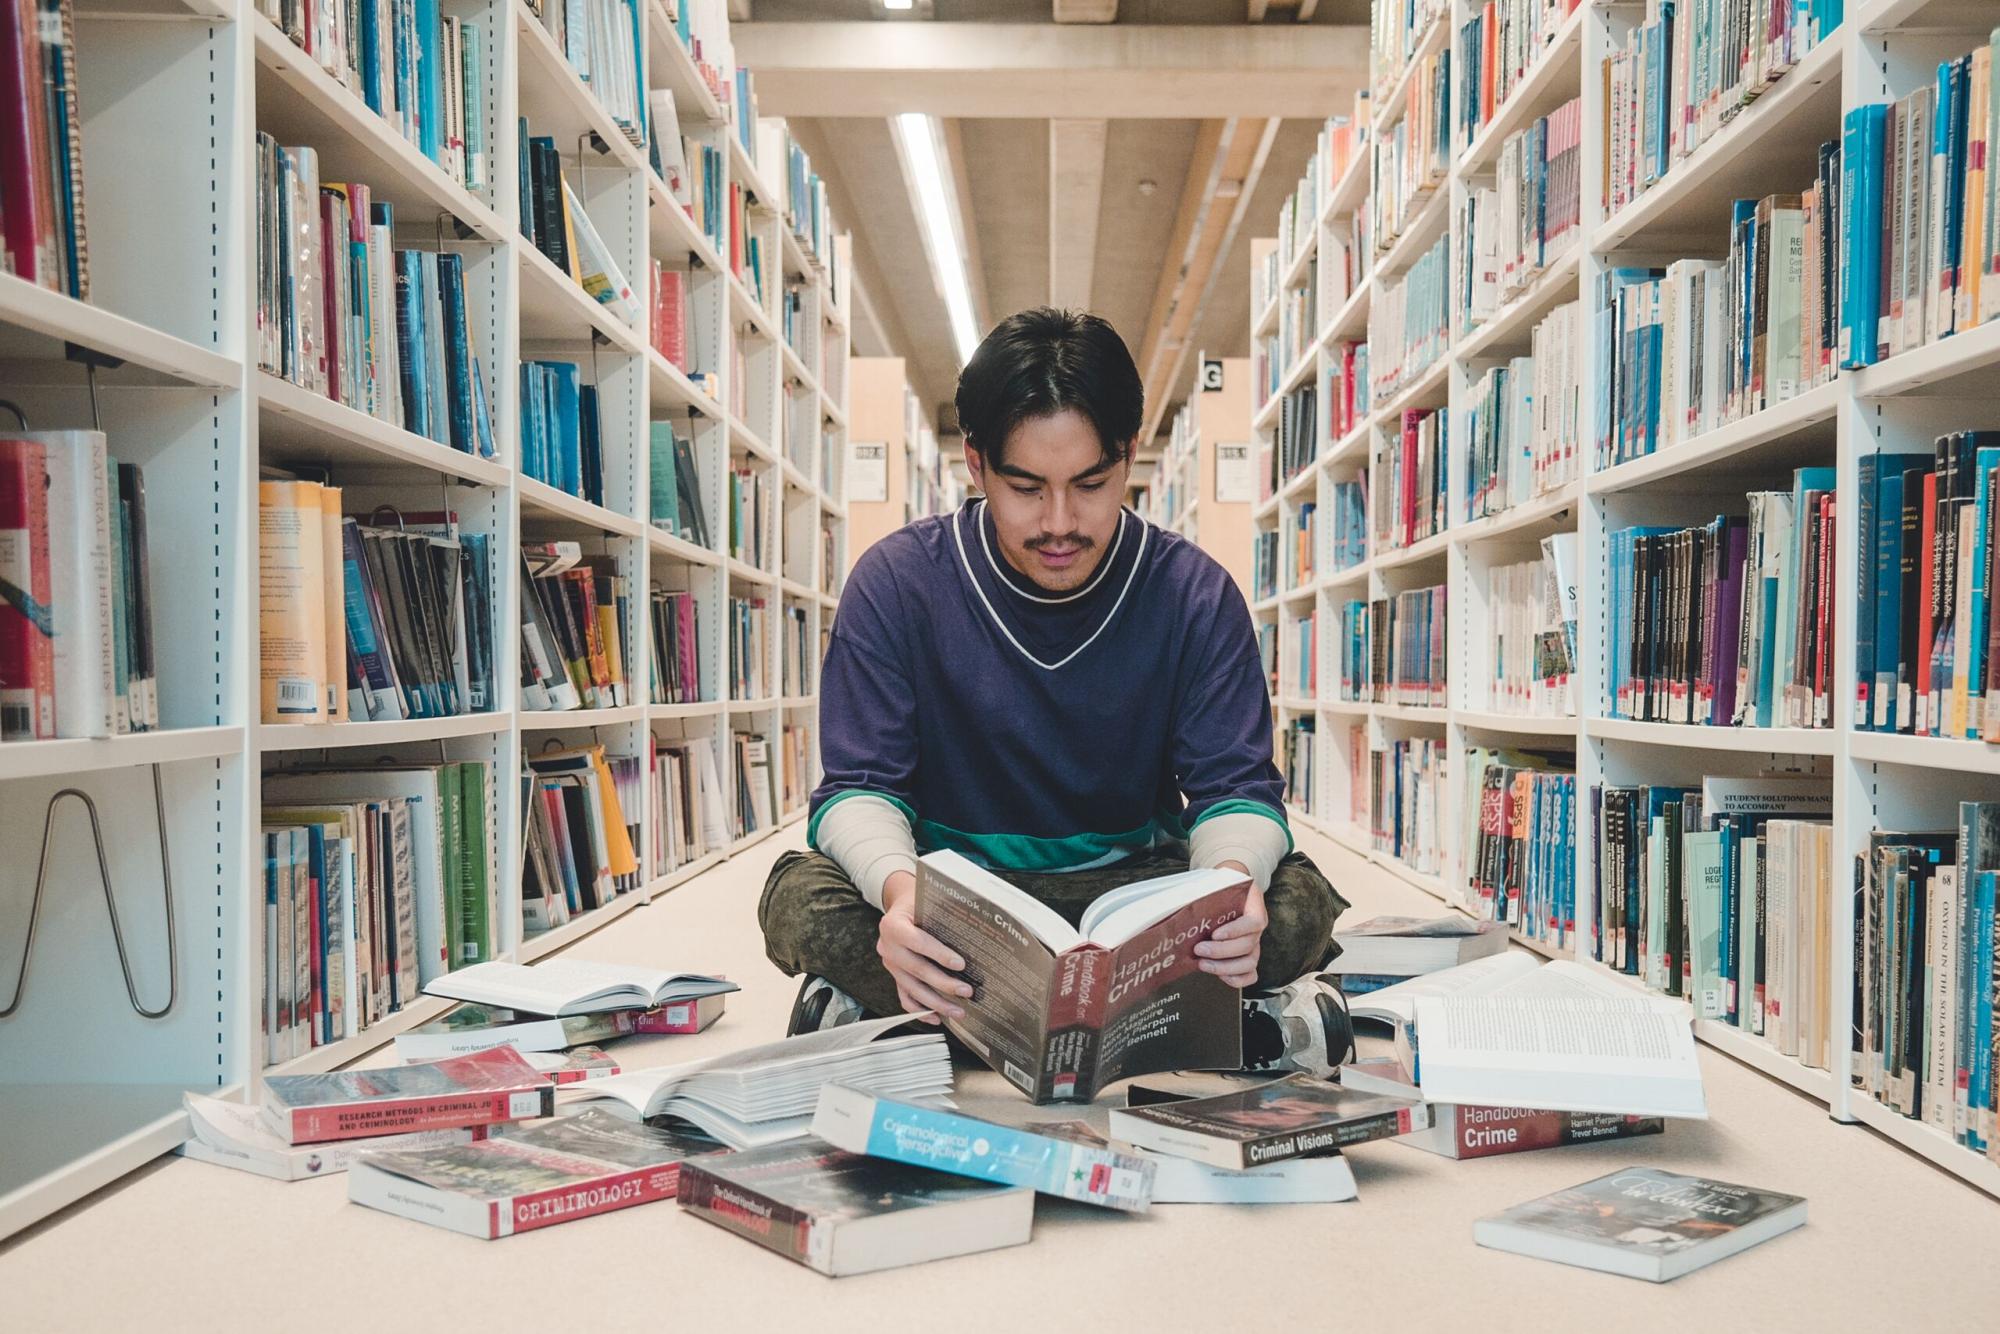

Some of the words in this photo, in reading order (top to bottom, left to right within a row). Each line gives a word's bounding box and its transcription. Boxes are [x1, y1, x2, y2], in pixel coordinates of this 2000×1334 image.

[1897, 117, 1905, 154] LINEAR
[1895, 158, 1903, 245] PROGRAMMING
[1204, 364, 1222, 388] G
[92, 446, 104, 534] NATURAL
[1986, 480, 1995, 544] Mathematical
[1858, 494, 1873, 601] Astronomy
[1983, 546, 1992, 599] Astronomy
[100, 587, 112, 691] HISTORIES
[1742, 615, 1750, 655] ANALYSIS
[452, 795, 460, 856] Maths
[1487, 793, 1501, 831] SPSS
[1513, 796, 1523, 827] SPSS
[1960, 824, 1969, 862] British
[1729, 846, 1737, 895] Smoothing
[1943, 874, 1952, 886] 68
[1959, 864, 1968, 895] Town
[925, 871, 980, 912] Handbook
[994, 914, 1029, 947] Crime
[1942, 901, 1950, 952] OXYGEN
[1957, 896, 1967, 927] Maps
[1111, 918, 1212, 984] Handbook
[1217, 910, 1237, 924] on
[1971, 908, 1981, 952] Principles
[1986, 924, 1994, 946] New
[1060, 954, 1080, 996] Crime
[1078, 950, 1099, 1005] Handbook
[1941, 954, 1949, 967] IN
[1973, 954, 1980, 963] of
[1983, 948, 1993, 1004] Cosmology
[1108, 954, 1176, 1003] Crime
[1940, 974, 1948, 996] THE
[1970, 964, 1978, 1008] cosmology
[1124, 1008, 1163, 1034] Maguire
[1129, 992, 1180, 1022] Brookman
[1133, 1011, 1180, 1036] Pierpoint
[1939, 1000, 1947, 1038] SOLAR
[1127, 1026, 1168, 1047] Bennett
[1969, 1028, 1977, 1075] gravitation
[1937, 1041, 1946, 1087] SYSTEM
[338, 1110, 383, 1121] RESEARCH
[386, 1107, 424, 1118] METHODS
[438, 1103, 477, 1112] CRIMINAL
[339, 1122, 356, 1131] AND
[360, 1118, 416, 1129] CRIMINOLOGY
[1464, 1107, 1536, 1124] Handbook
[1571, 1119, 1593, 1129] Harriet
[883, 1117, 969, 1147] Criminological
[1250, 1138, 1295, 1161] Criminal
[1296, 1132, 1334, 1151] Visions
[1464, 1127, 1518, 1148] Crime
[1571, 1129, 1591, 1138] Trevor
[1593, 1126, 1618, 1137] Bennett
[518, 1179, 643, 1222] CRIMINOLOGY
[1649, 1194, 1740, 1215] CONTEXT
